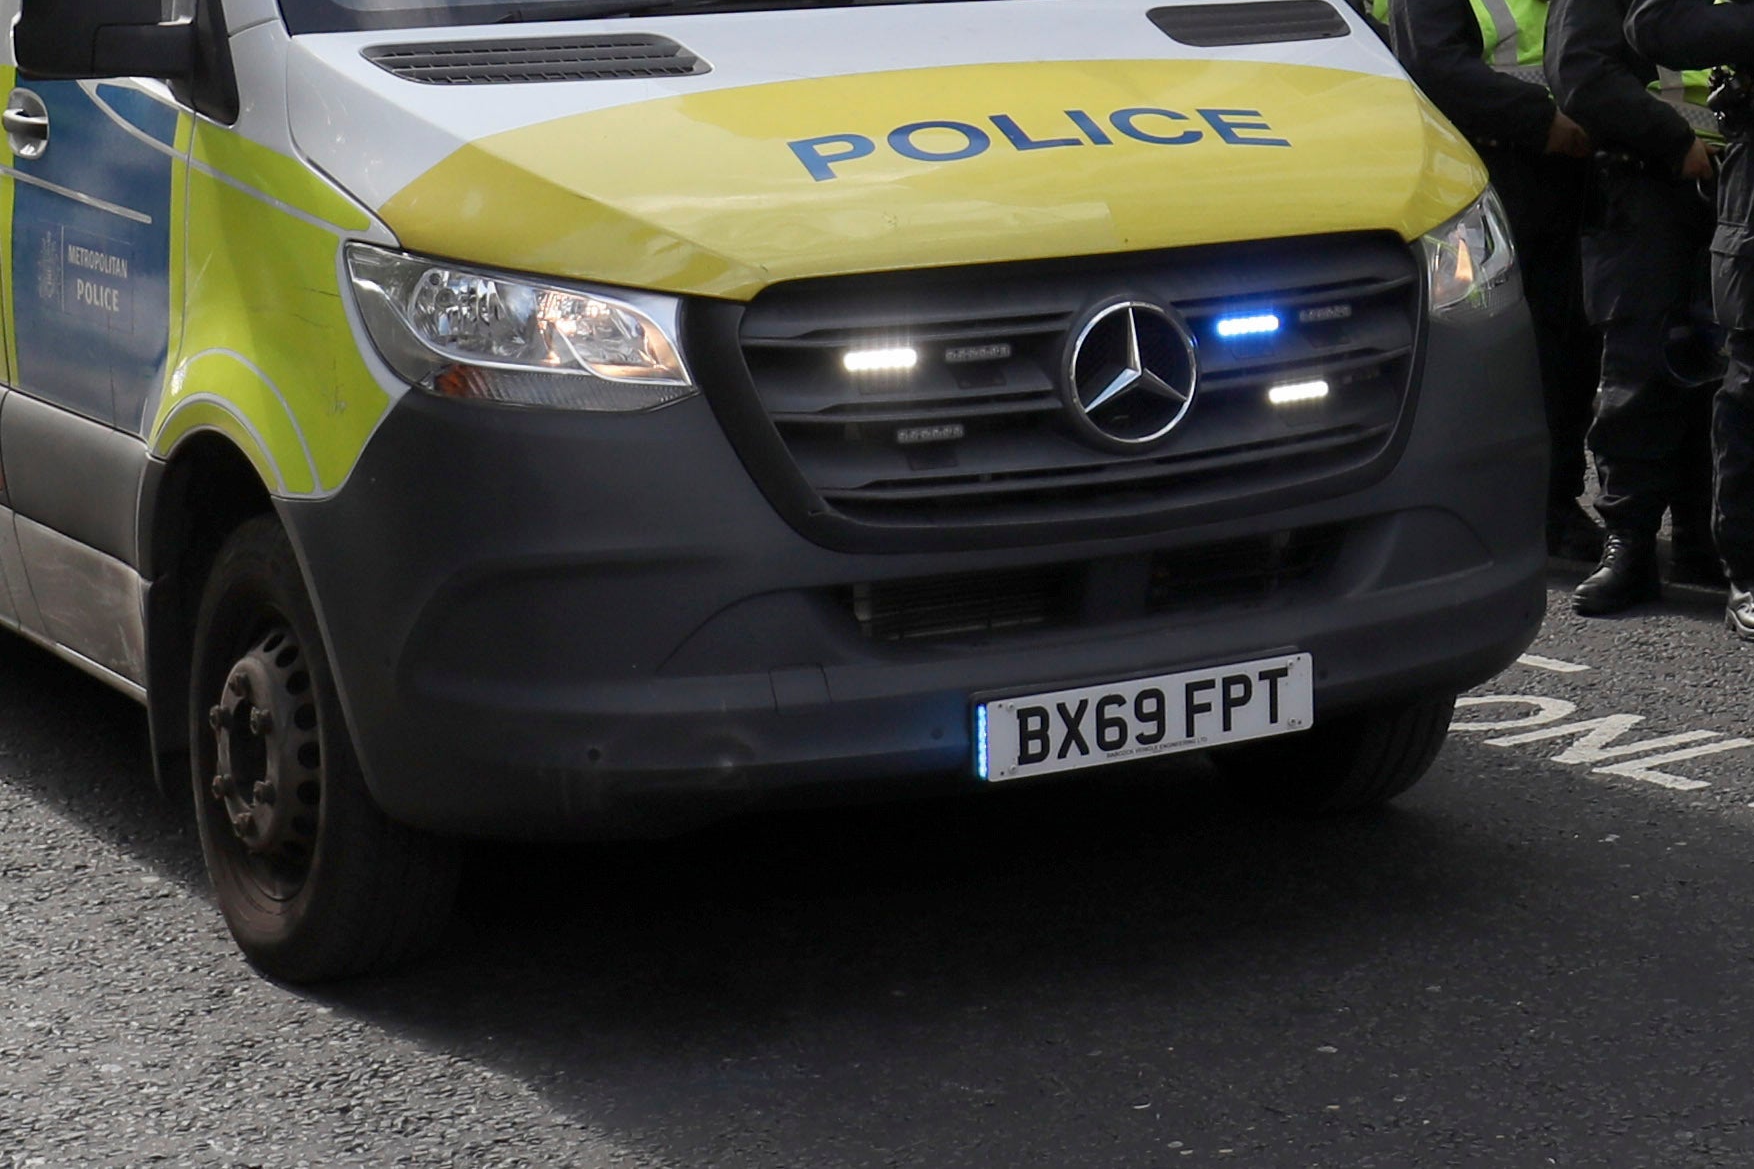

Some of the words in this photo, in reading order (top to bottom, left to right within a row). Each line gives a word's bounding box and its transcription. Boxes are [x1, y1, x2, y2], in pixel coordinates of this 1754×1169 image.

[787, 108, 1292, 182] POLICE
[68, 244, 128, 279] METROPOLITAN
[77, 278, 119, 312] POLICE
[1016, 687, 1167, 766] BX69
[1184, 667, 1289, 738] FPT
